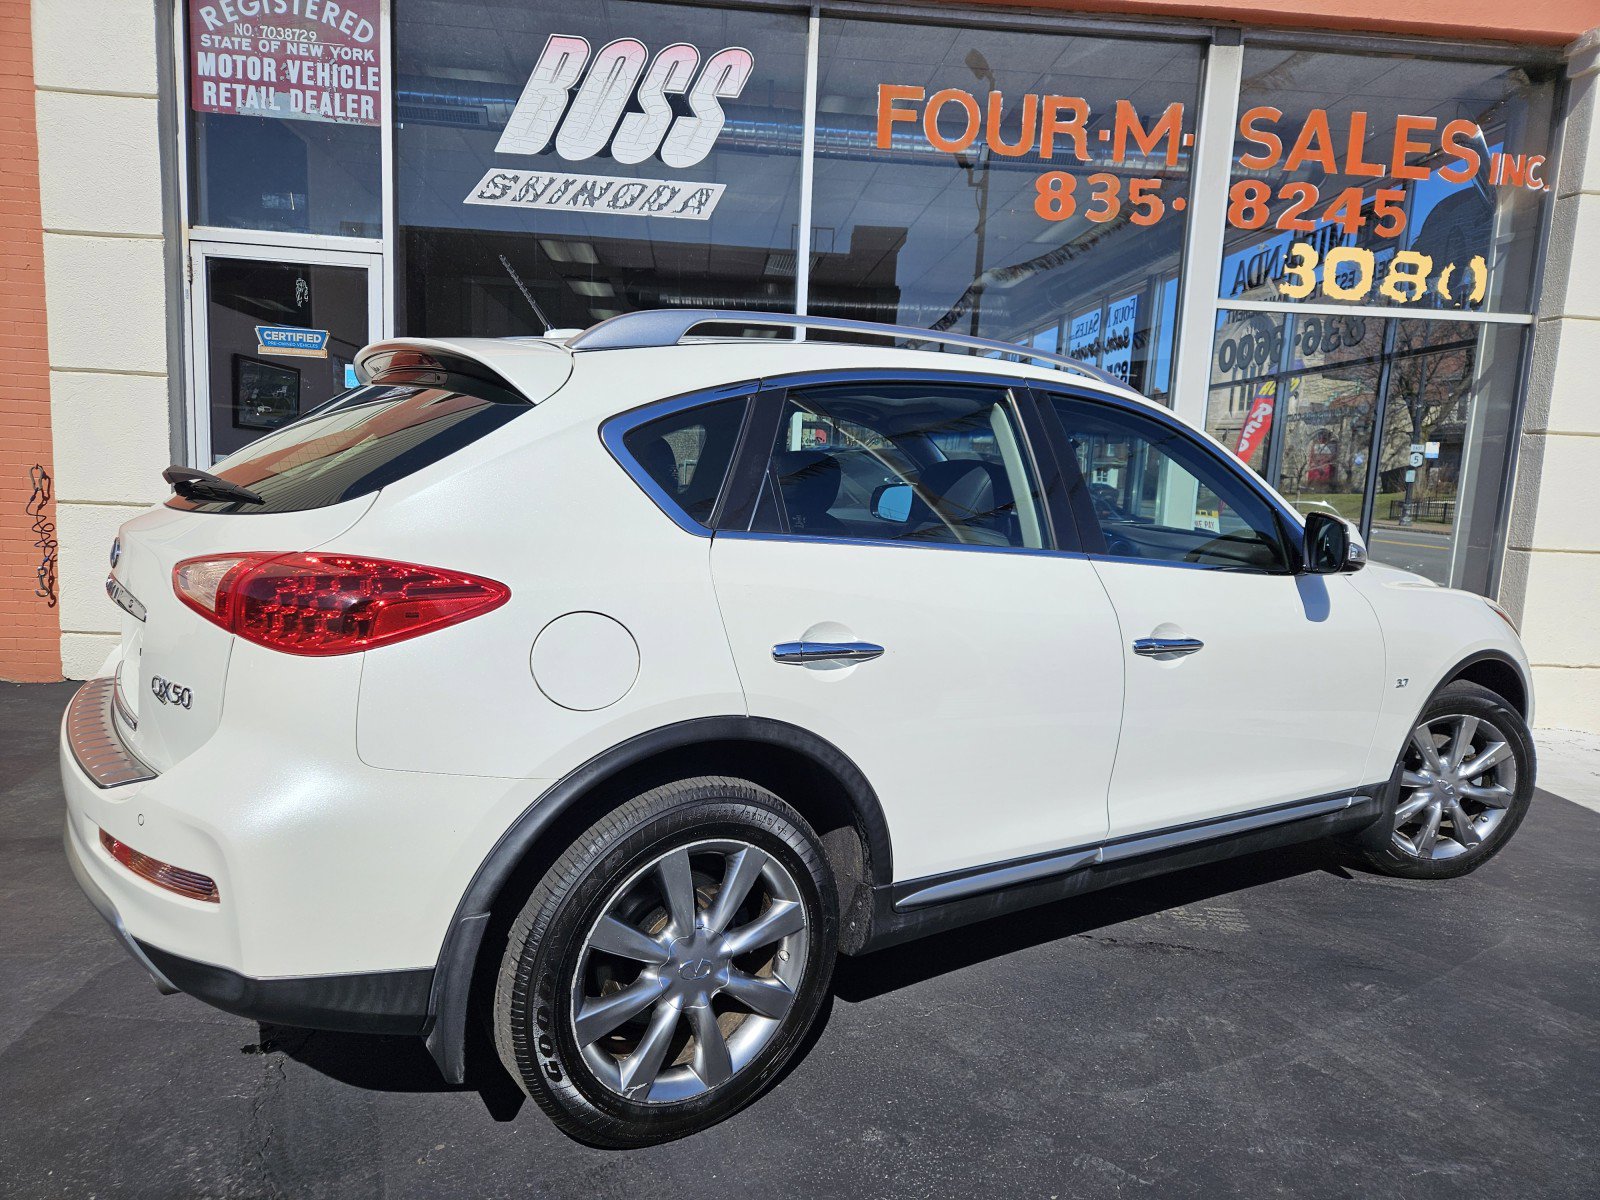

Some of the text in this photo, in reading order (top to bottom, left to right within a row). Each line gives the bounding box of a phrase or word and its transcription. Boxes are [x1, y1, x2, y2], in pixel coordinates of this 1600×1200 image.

[199, 0, 374, 43] REGISTERED
[260, 25, 317, 43] 7038729
[200, 33, 375, 62] STATE OF NEW YORK
[197, 51, 380, 92] MOTOR VEHICLE
[202, 81, 375, 120] RETAIL DEALER
[494, 33, 755, 168] BOSS
[1238, 105, 1482, 184] SALES
[1488, 152, 1551, 192] INC.
[1227, 179, 1408, 239] 8245
[263, 330, 322, 344] CERTIFIED
[151, 674, 194, 710] QX50
